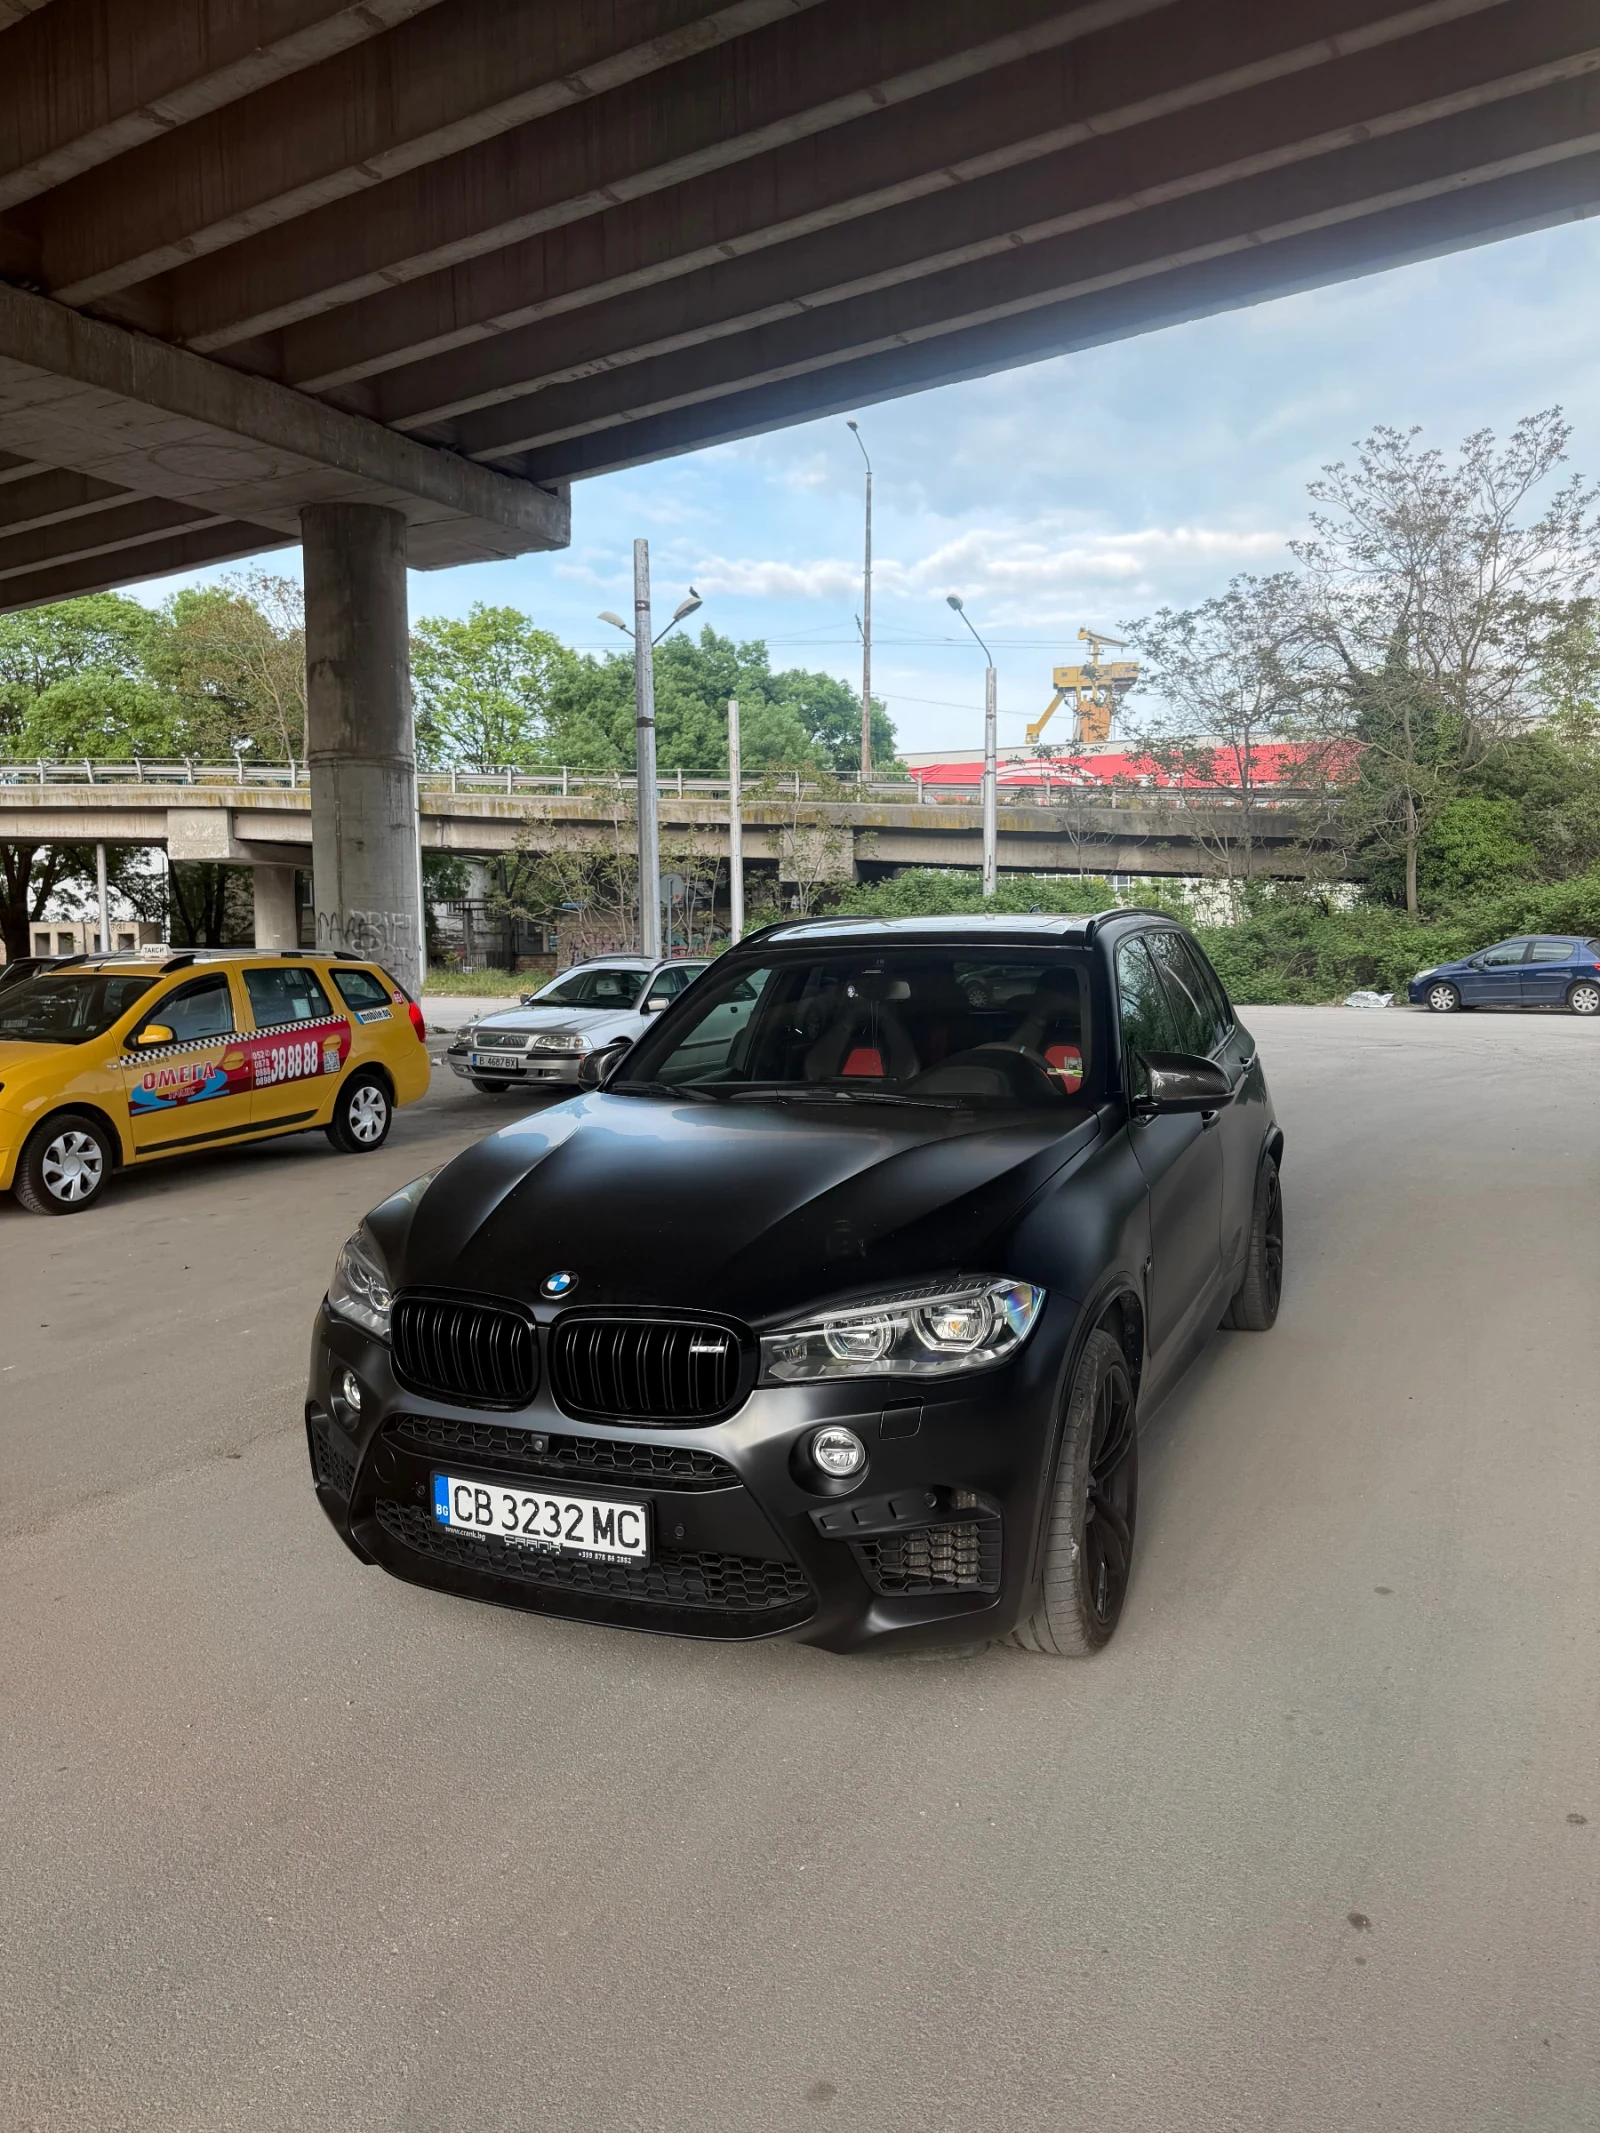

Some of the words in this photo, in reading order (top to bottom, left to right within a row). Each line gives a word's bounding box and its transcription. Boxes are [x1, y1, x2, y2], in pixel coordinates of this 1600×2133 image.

[252, 1050, 265, 1060] 052
[142, 1060, 216, 1092] ОМЕГА
[436, 1503, 449, 1516] BG
[454, 1485, 493, 1526] CB
[501, 1494, 584, 1543] 3232
[592, 1506, 640, 1549] MC
[445, 1526, 486, 1541] www.crank.bg
